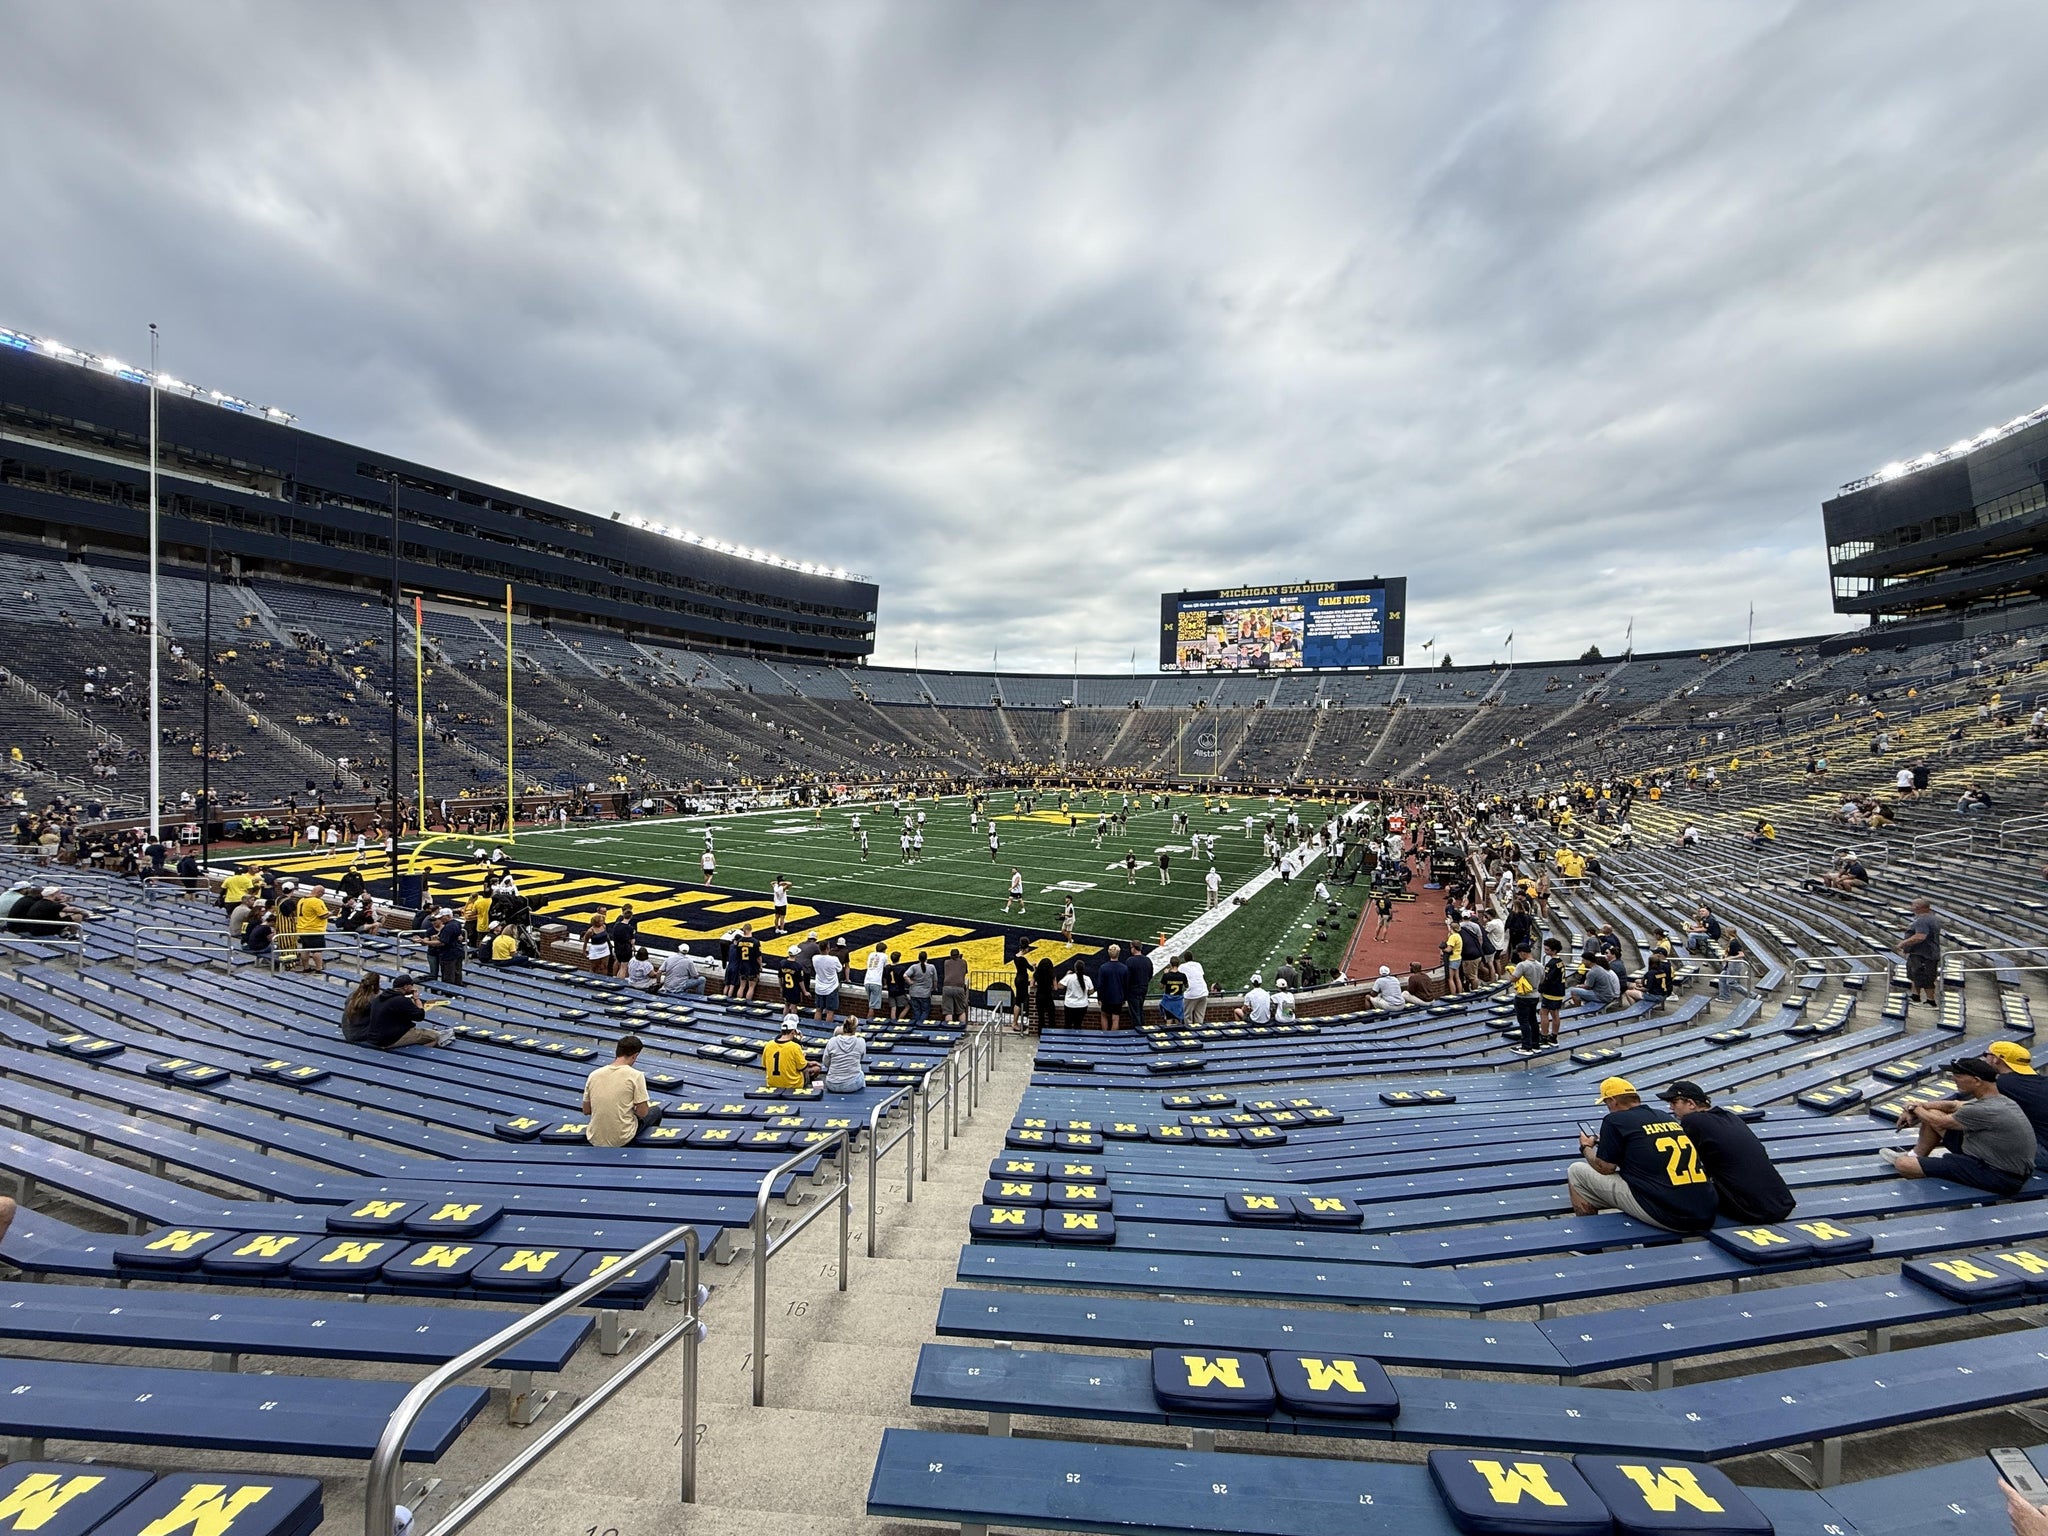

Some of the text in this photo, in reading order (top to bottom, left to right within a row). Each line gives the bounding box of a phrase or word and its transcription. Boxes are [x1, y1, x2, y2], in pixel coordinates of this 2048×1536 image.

[1220, 583, 1335, 598] MICHIGAN STADIUM
[1318, 594, 1371, 606] GAME NOTES
[1389, 611, 1400, 620] M
[741, 946, 750, 960] 2
[784, 974, 794, 988] 9
[890, 970, 896, 984] 1
[773, 1052, 781, 1076] 1
[1424, 1090, 1445, 1098] M
[1172, 1096, 1192, 1104] M
[678, 1103, 702, 1112] M
[721, 1104, 744, 1114] M
[765, 1104, 788, 1114] M
[1309, 1109, 1332, 1117] M
[778, 1116, 804, 1126] M
[1190, 1116, 1212, 1124] M
[1231, 1114, 1254, 1122] M
[1271, 1112, 1295, 1120] M
[508, 1118, 538, 1129] M
[826, 1119, 850, 1128] M
[1024, 1119, 1046, 1128] M
[1070, 1121, 1090, 1130] M
[1115, 1124, 1136, 1132] M
[652, 1128, 680, 1138] M
[702, 1130, 730, 1140] M
[1020, 1130, 1042, 1140] M
[1160, 1126, 1182, 1136] M
[1206, 1128, 1230, 1138] M
[1250, 1126, 1275, 1137] M
[753, 1132, 780, 1142] M
[1068, 1134, 1091, 1144] M
[1655, 1135, 1708, 1186] 22
[1006, 1161, 1034, 1172] M
[1065, 1164, 1092, 1176] M
[888, 1184, 902, 1194] 12
[1002, 1182, 1032, 1196] M
[1066, 1186, 1096, 1198] M
[1242, 1196, 1278, 1209] M
[1308, 1198, 1346, 1210] M
[352, 1200, 405, 1218] M
[430, 1204, 482, 1220] M
[990, 1208, 1025, 1224] M
[1063, 1213, 1098, 1229] M
[1796, 1222, 1851, 1240] M
[146, 1230, 214, 1252] M
[1734, 1228, 1790, 1246] M
[234, 1236, 298, 1256] M
[320, 1242, 383, 1262] M
[412, 1246, 472, 1268] M
[500, 1250, 558, 1272] M
[818, 1264, 838, 1278] 15
[1930, 1260, 1998, 1282] M
[785, 1300, 809, 1317] 16
[968, 1368, 980, 1376] 23
[1182, 1356, 1244, 1388] M
[1298, 1358, 1365, 1392] M
[1089, 1378, 1100, 1386] 24
[10, 1385, 32, 1394] 20
[134, 1394, 152, 1402] 21
[259, 1402, 278, 1410] 22
[1445, 1402, 1457, 1410] 27
[1566, 1409, 1581, 1418] 28
[928, 1462, 943, 1473] 24
[1066, 1472, 1080, 1484] 25
[1470, 1460, 1566, 1506] M
[1212, 1484, 1228, 1494] 26
[1617, 1465, 1724, 1512] M
[1, 1473, 104, 1530] M
[1359, 1494, 1374, 1505] 27
[1947, 1503, 1966, 1515] 31
[1823, 1524, 1844, 1536] 30
